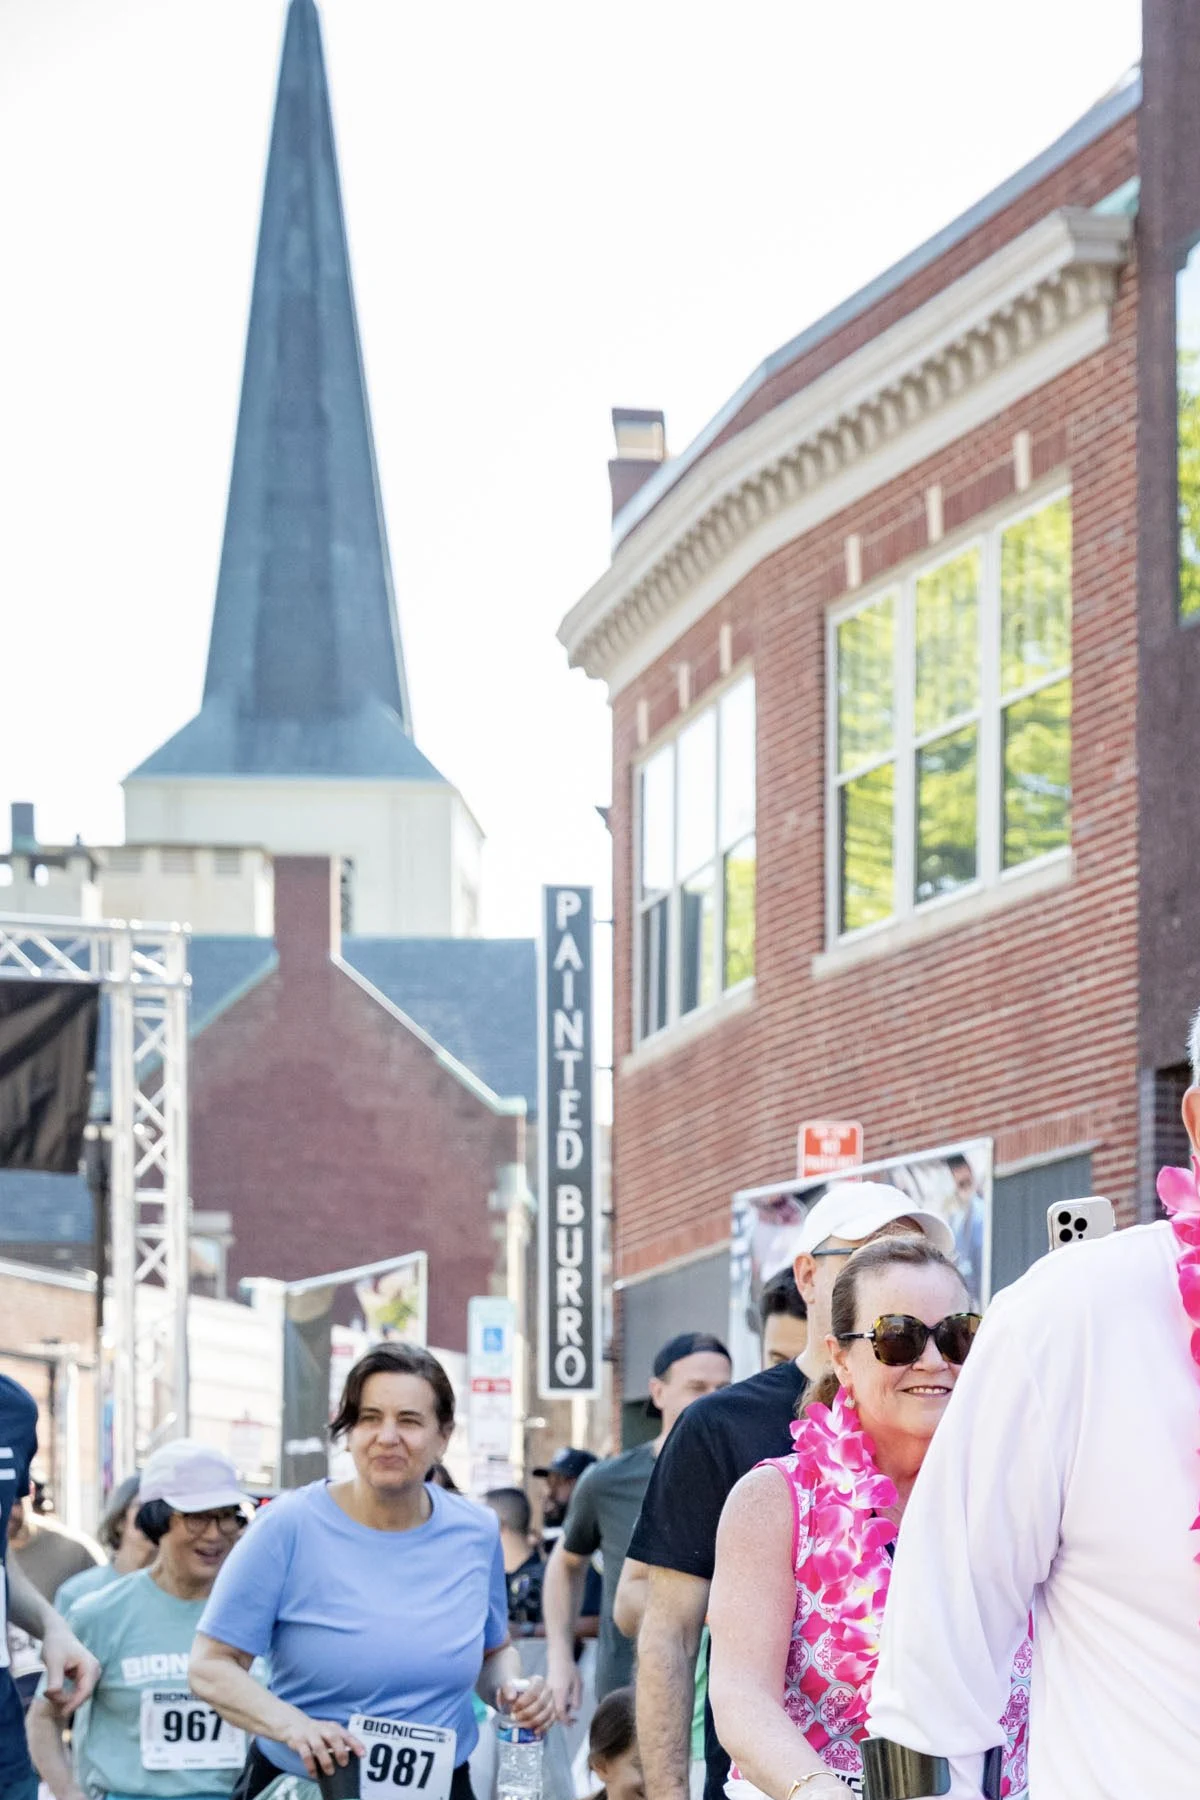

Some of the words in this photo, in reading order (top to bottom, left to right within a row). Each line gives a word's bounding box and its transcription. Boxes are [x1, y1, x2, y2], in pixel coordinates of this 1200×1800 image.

[554, 890, 584, 1170] PAINTED
[555, 1185, 586, 1386] BURRO
[164, 1710, 223, 1743] 967
[363, 1720, 436, 1742] BIONIC
[367, 1743, 436, 1789] 987
